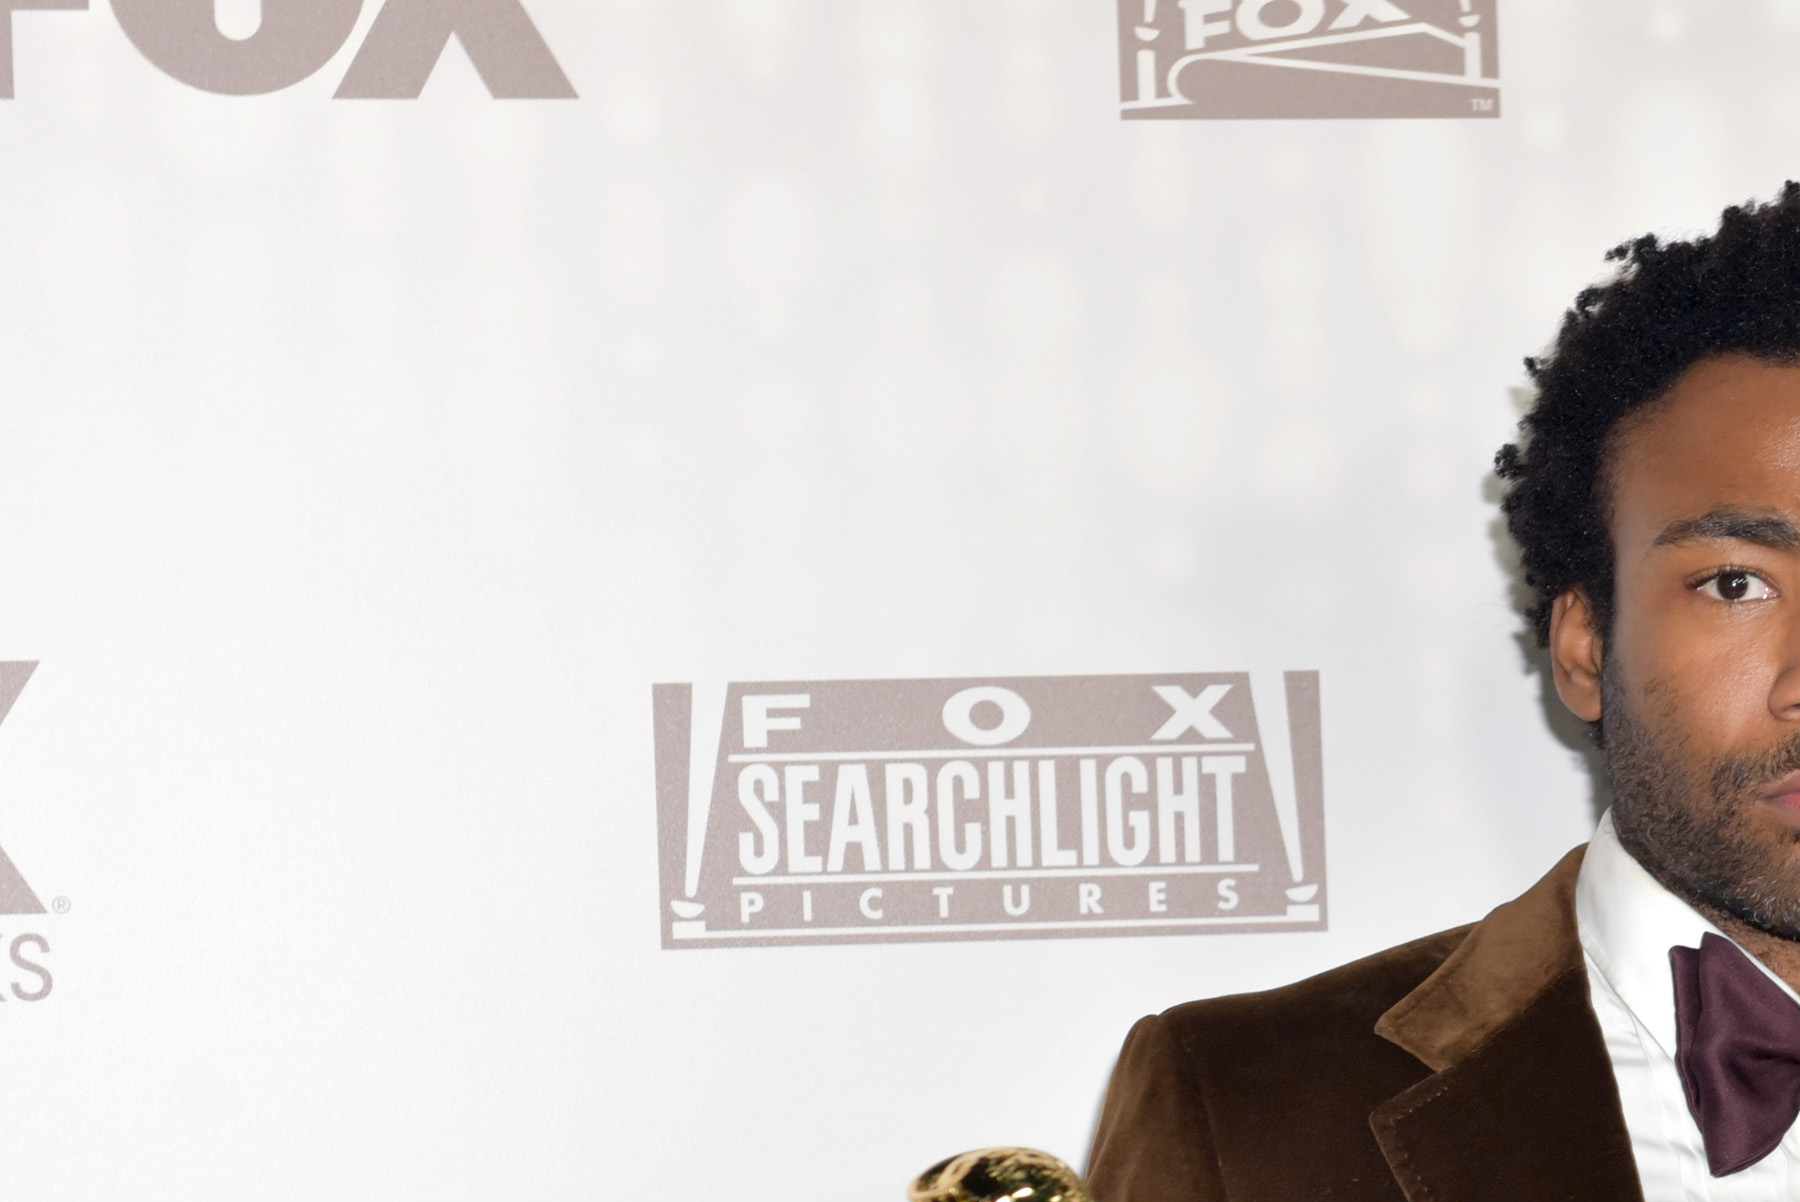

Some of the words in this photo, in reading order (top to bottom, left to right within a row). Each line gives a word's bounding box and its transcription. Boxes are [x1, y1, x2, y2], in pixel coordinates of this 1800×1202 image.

[741, 683, 1236, 748] FOX
[737, 755, 1247, 876] SEARCHLIGHT
[739, 878, 1239, 922] PICTURES
